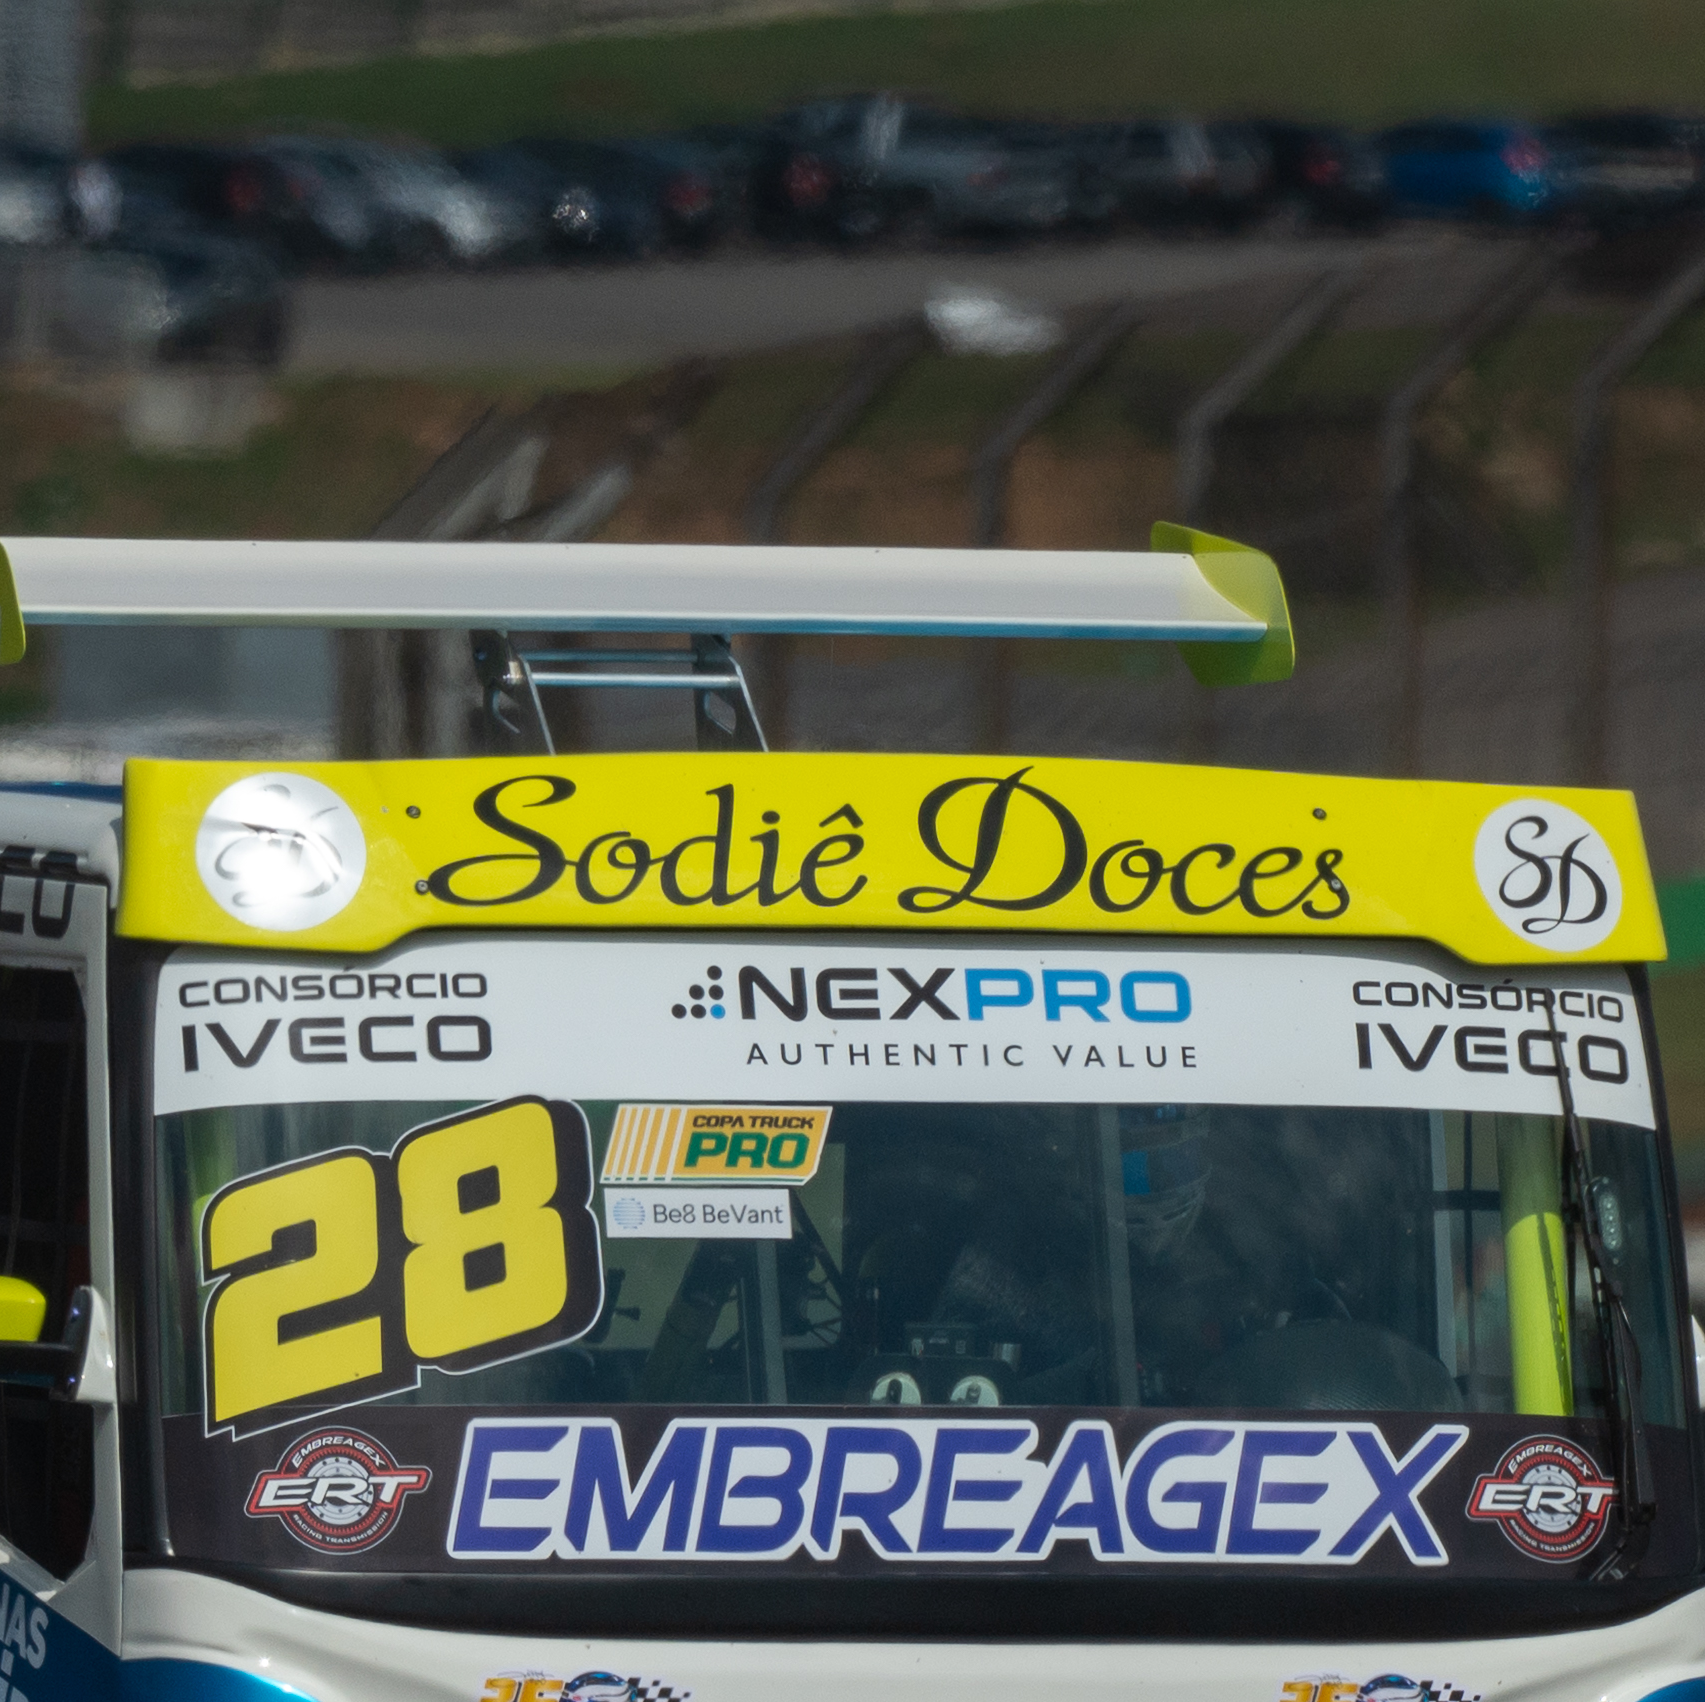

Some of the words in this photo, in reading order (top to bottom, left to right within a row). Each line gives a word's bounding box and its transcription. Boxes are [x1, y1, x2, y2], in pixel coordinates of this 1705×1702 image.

[428, 775, 868, 907] Sodiê
[897, 766, 1351, 920] Doces
[738, 965, 1192, 1022] NEXPRO
[1351, 979, 1625, 1022] CONSÓRCIO
[181, 1015, 493, 1073] IVECO
[747, 1042, 1025, 1066] AUTHENTIC
[1053, 1044, 1198, 1067] VALUE
[1356, 1022, 1629, 1084] IVECO
[692, 1115, 745, 1129] COPA
[748, 1116, 815, 1129] TRUCK
[684, 1131, 810, 1169] PRO
[653, 1203, 696, 1224] Be8
[702, 1204, 784, 1225] BeVant
[205, 1099, 580, 1427] 28
[291, 1436, 386, 1469] EMBREAGEX
[1508, 1444, 1593, 1477] EMBREAGEX
[258, 1475, 419, 1507] ERT
[450, 1419, 1467, 1562] EMBREAGEX
[1478, 1483, 1614, 1514] ERT
[293, 1514, 323, 1541] RACING
[326, 1511, 389, 1544] TRANSMISSION
